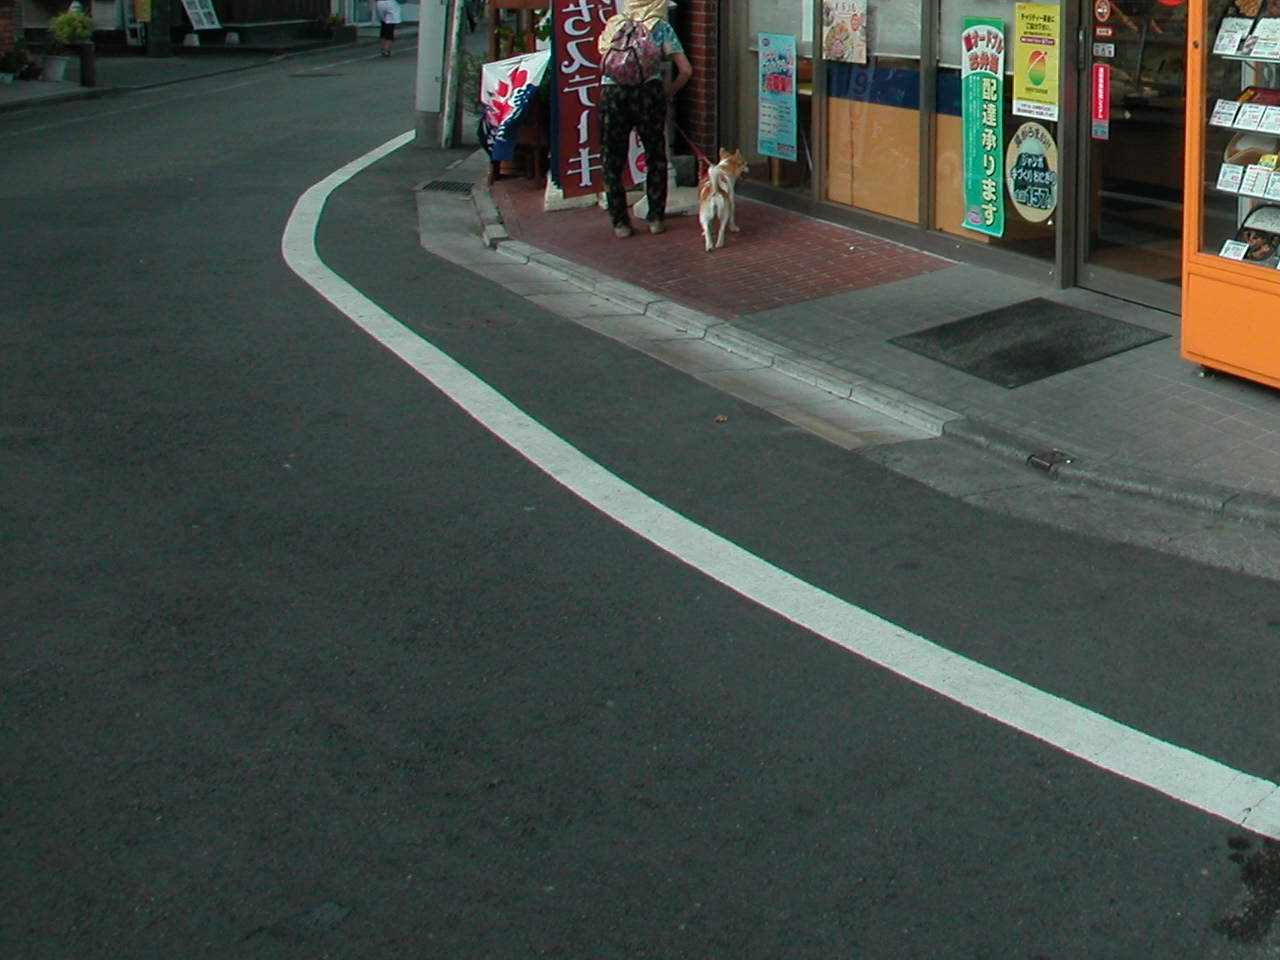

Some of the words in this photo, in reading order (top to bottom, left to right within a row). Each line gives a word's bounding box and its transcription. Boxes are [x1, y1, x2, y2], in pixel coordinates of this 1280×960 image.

[981, 77, 998, 226] 配達承ります
